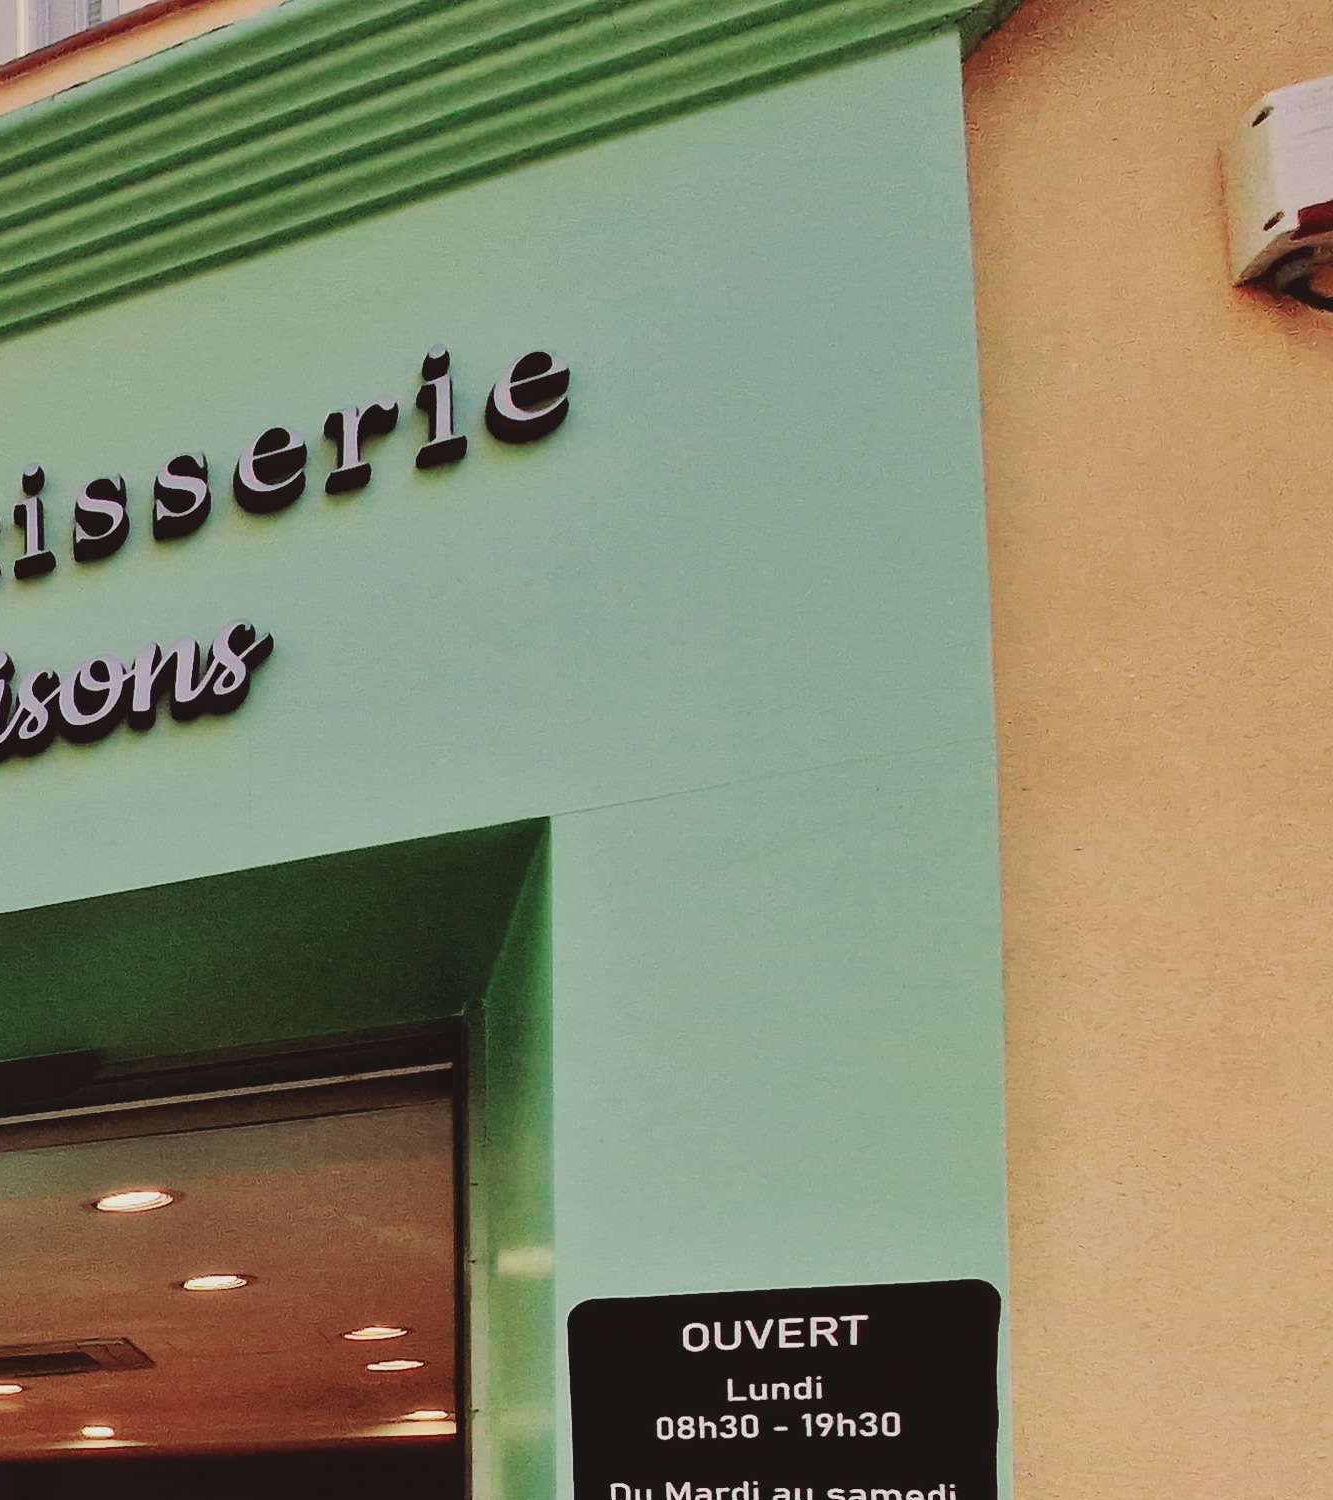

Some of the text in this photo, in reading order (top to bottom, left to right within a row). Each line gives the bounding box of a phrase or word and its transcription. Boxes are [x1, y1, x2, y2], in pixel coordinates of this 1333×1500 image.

[682, 1315, 869, 1352] OUVERT
[726, 1376, 823, 1402] Lundi
[656, 1414, 759, 1441] 08h30
[801, 1412, 901, 1437] 19h30
